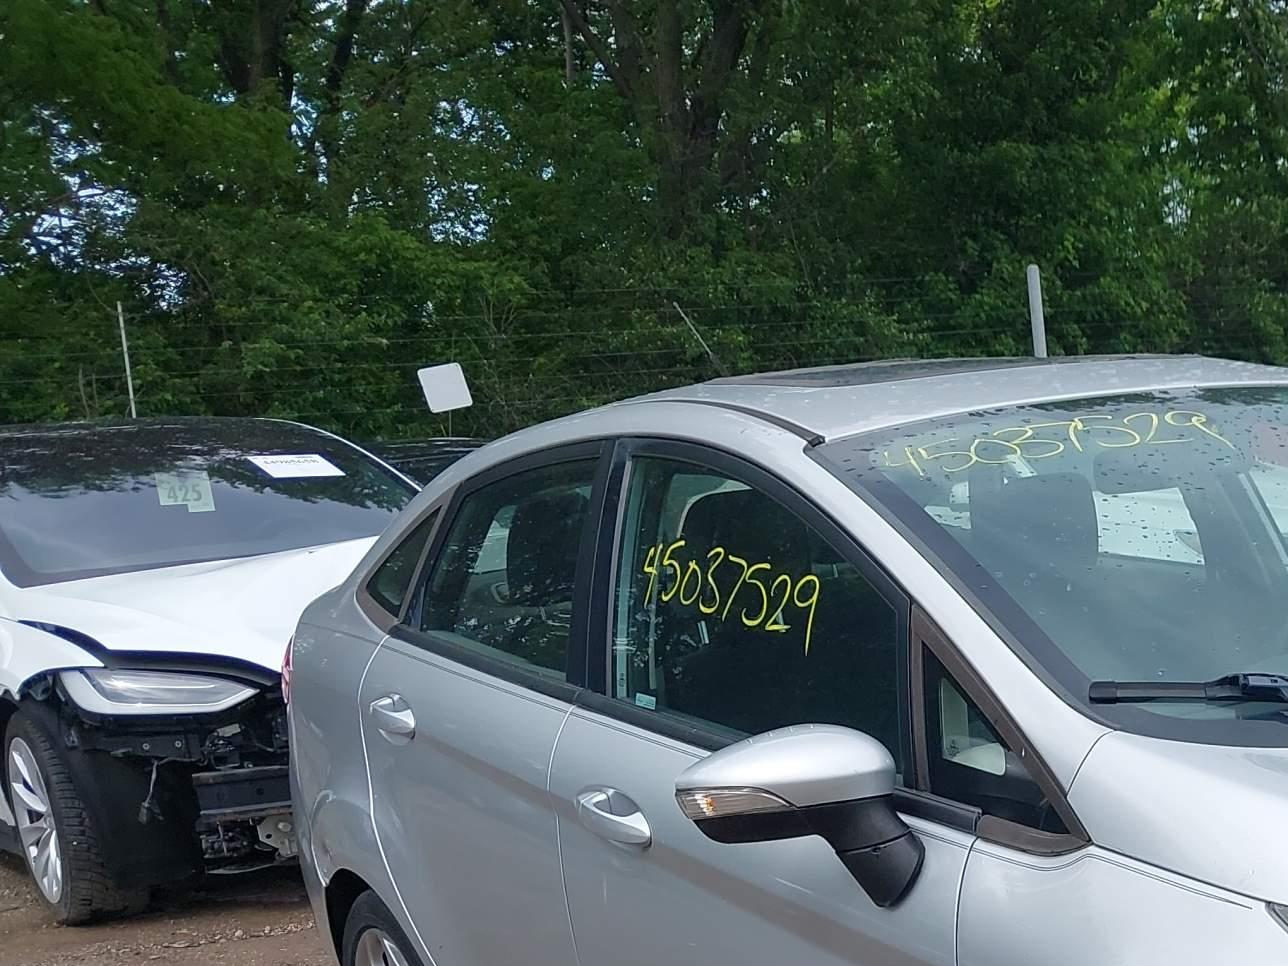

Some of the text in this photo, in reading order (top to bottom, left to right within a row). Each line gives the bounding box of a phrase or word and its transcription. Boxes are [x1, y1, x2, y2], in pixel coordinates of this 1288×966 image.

[880, 411, 1236, 480] 45037529
[167, 483, 202, 503] 425
[643, 540, 820, 657] 45037529
